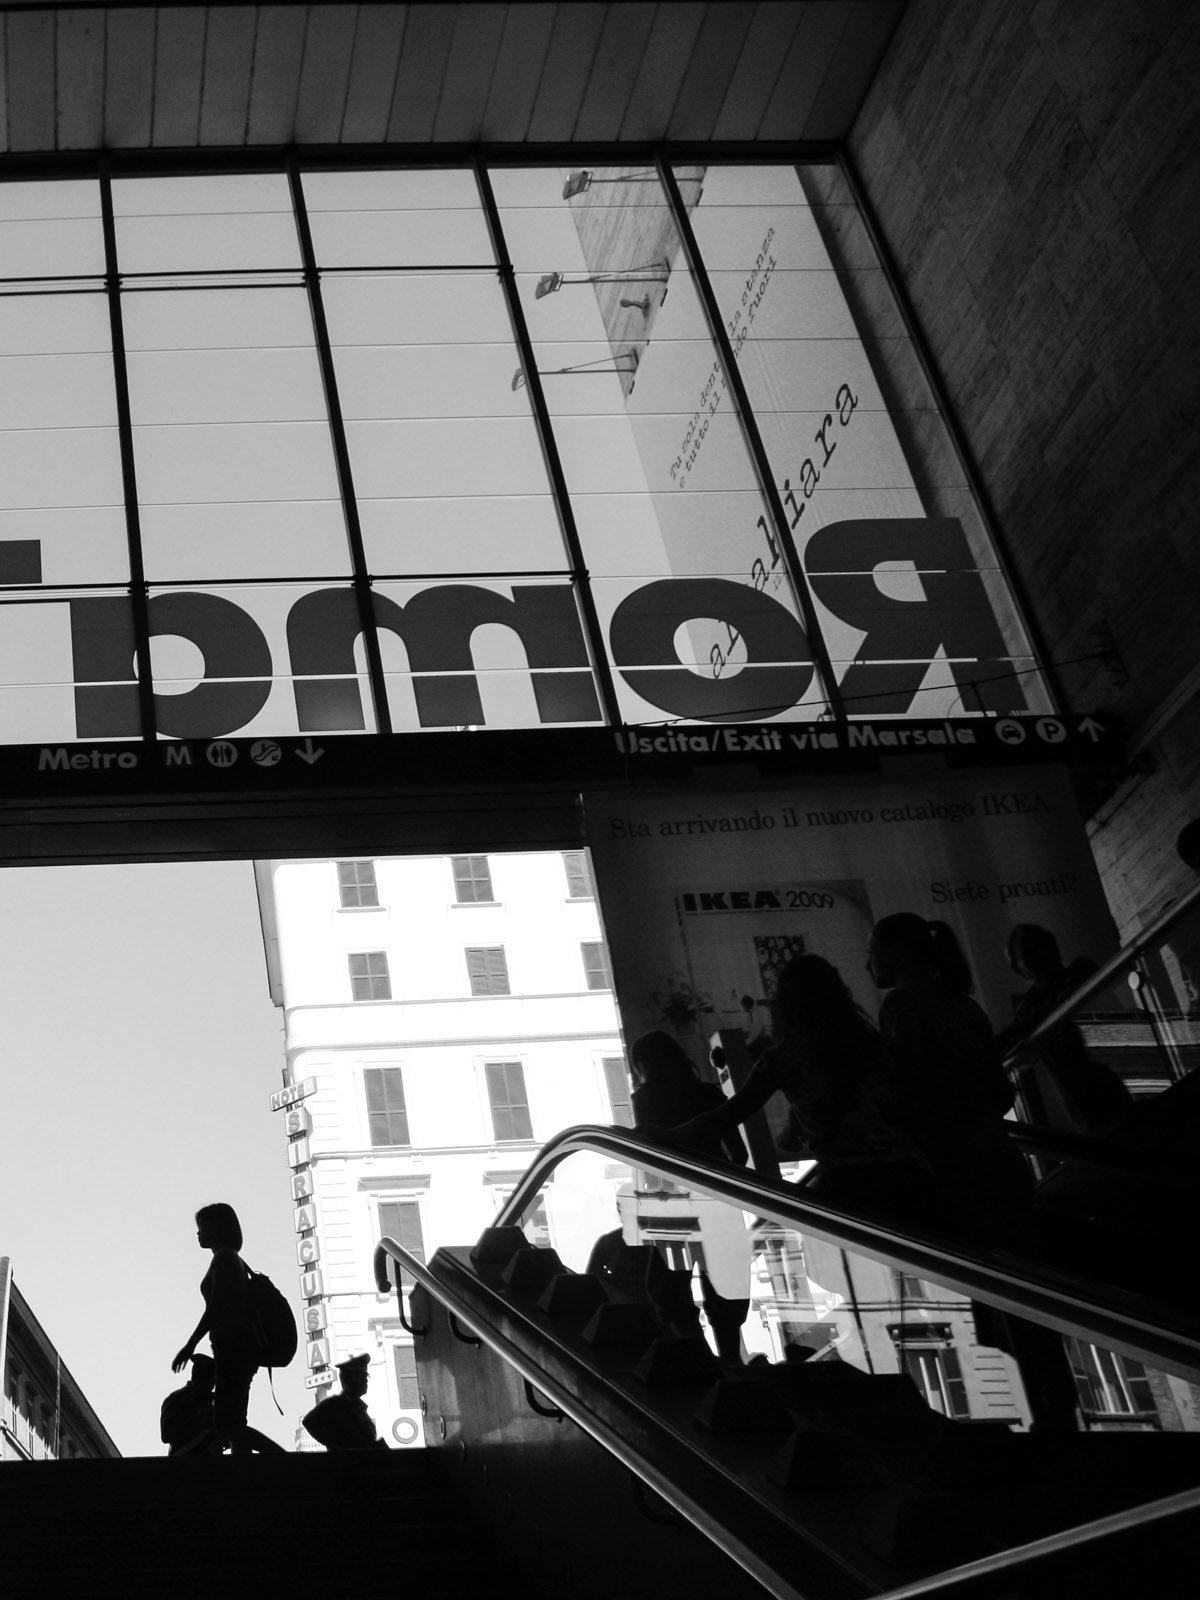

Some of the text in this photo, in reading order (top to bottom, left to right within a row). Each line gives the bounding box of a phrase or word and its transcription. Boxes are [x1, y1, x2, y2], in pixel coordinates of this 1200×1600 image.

[791, 726, 838, 750] via
[847, 722, 976, 748] Marsala
[37, 745, 192, 771] Metro M
[610, 818, 651, 839] Sta
[660, 811, 776, 836] arrivando
[783, 807, 799, 829] il
[806, 810, 874, 827] nuovo
[881, 801, 975, 824] catalogo
[683, 891, 835, 911] IKEA 2009
[931, 872, 1079, 904] Siete pronti?
[288, 1111, 324, 1366] SIRACUSA
